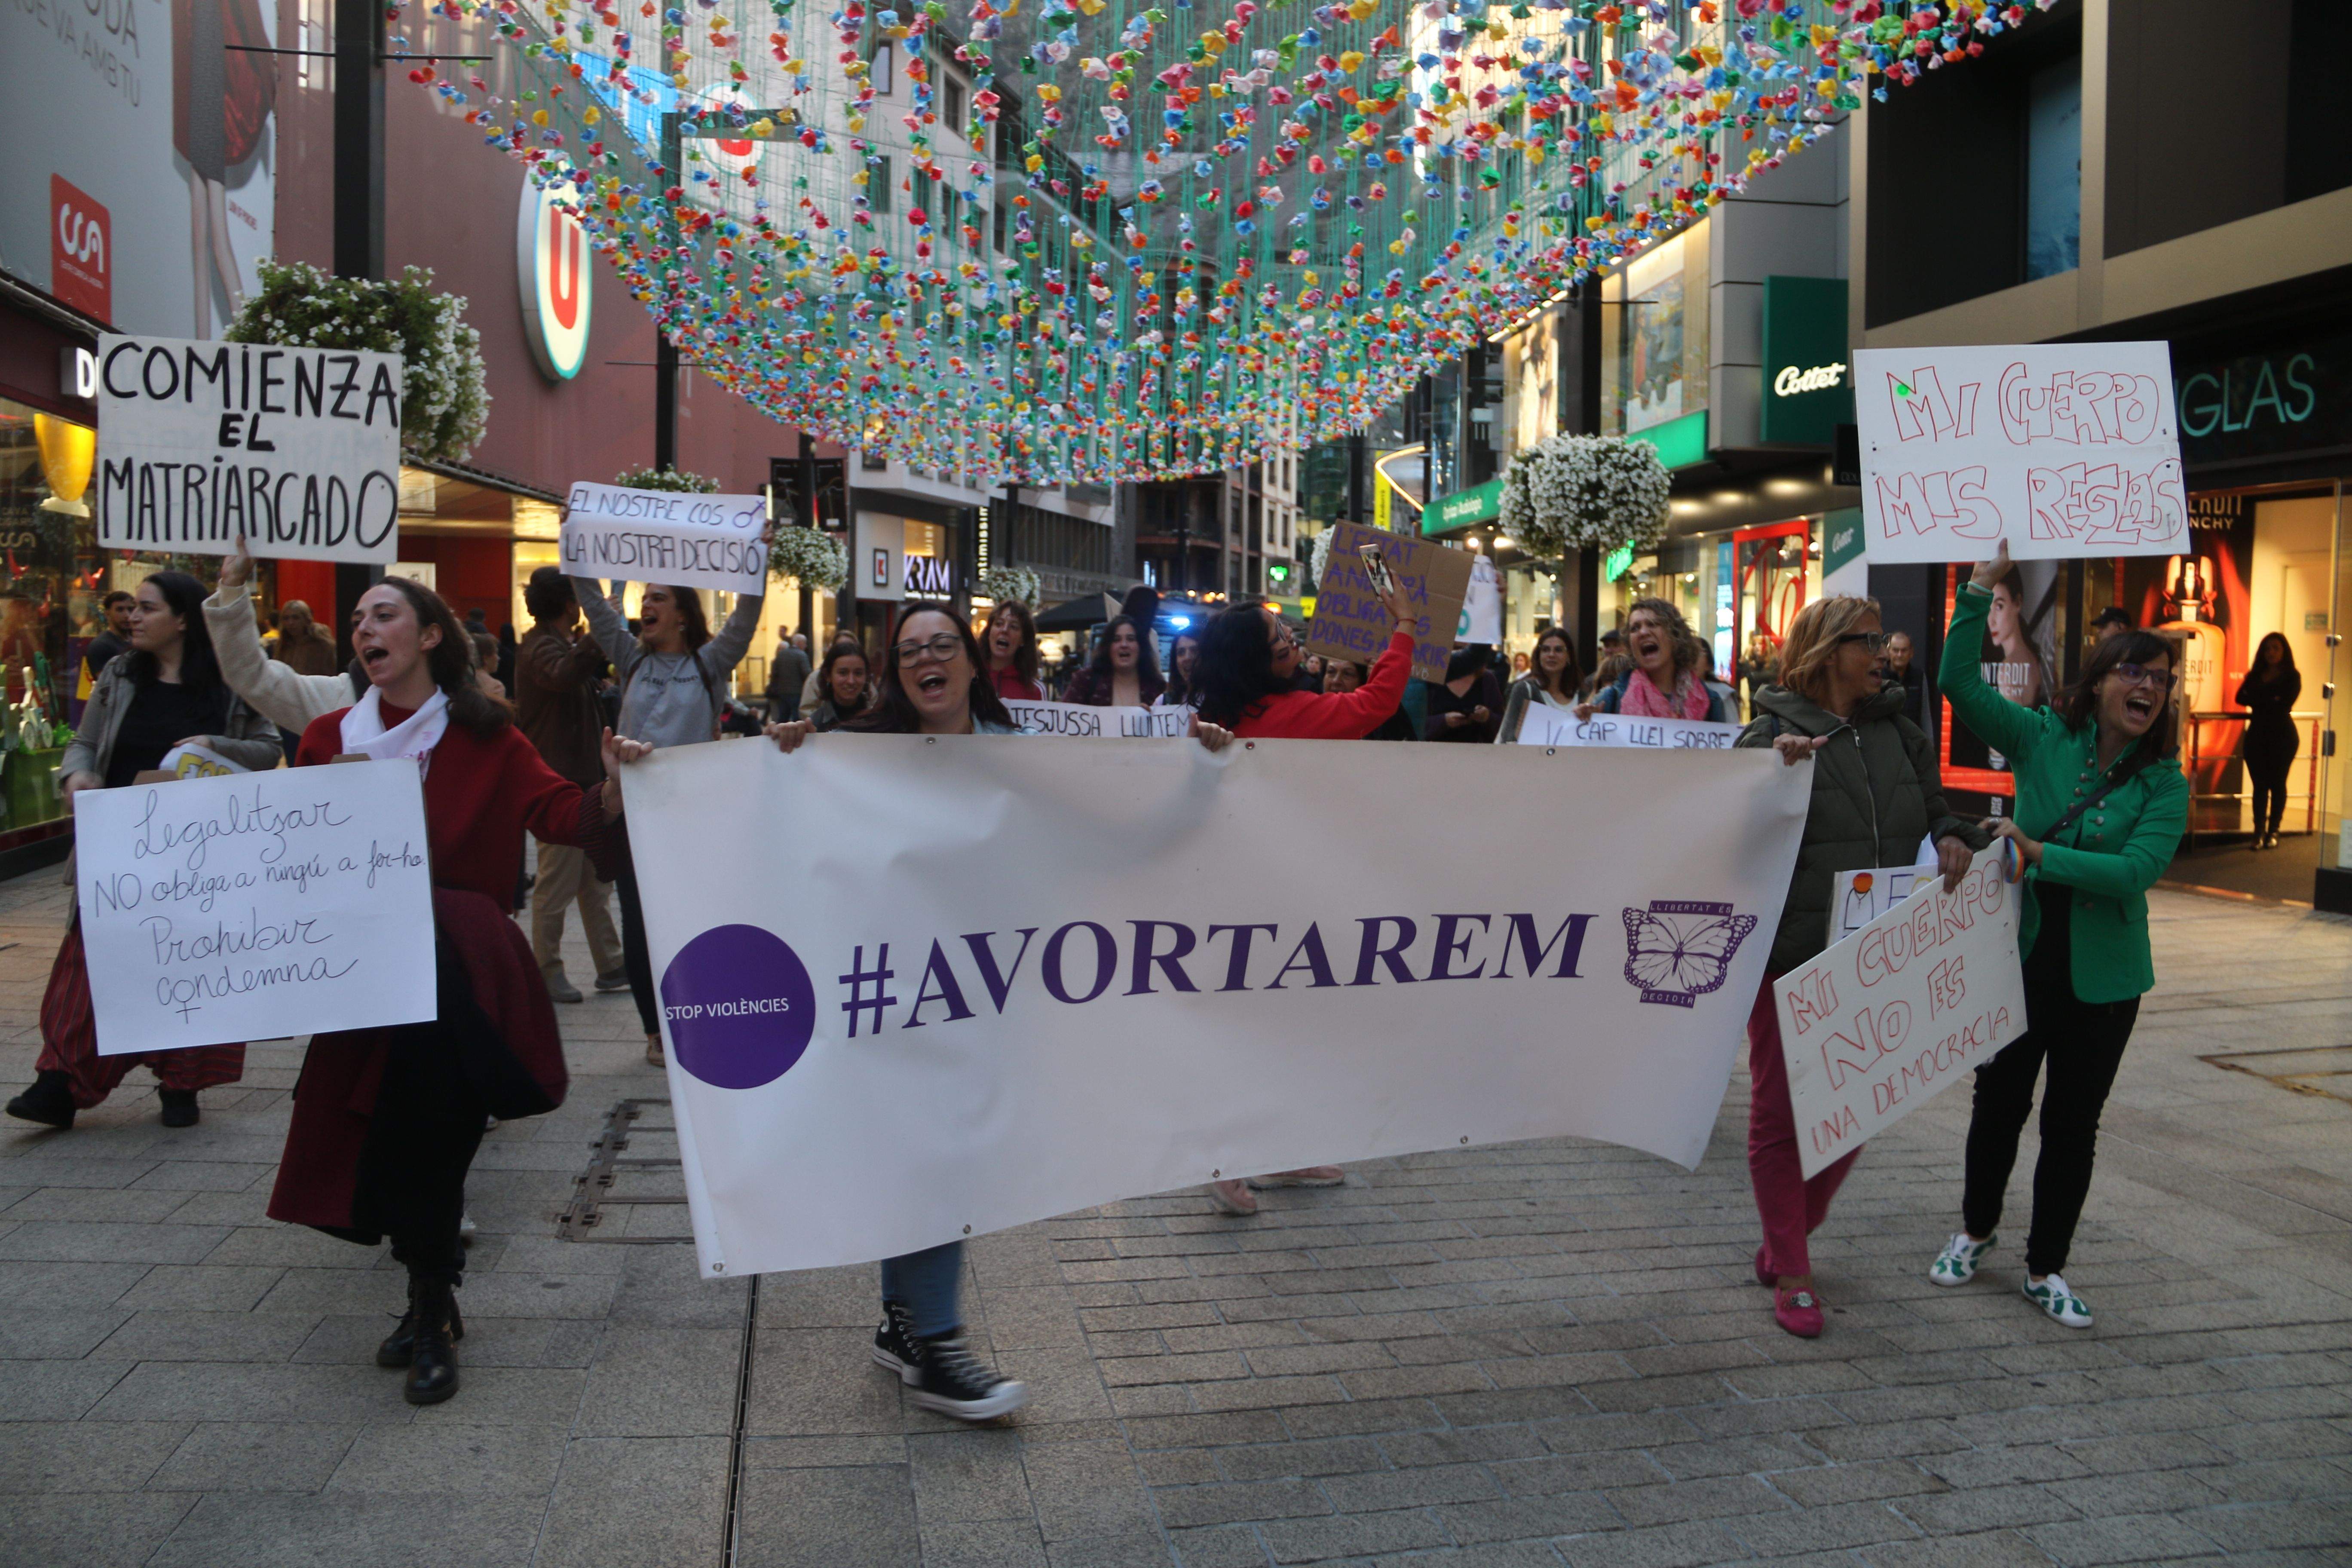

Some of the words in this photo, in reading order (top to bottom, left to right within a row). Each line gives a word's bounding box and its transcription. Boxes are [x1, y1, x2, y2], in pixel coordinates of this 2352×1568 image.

[103, 342, 398, 428] COMIENZA
[1774, 362, 1847, 397] Cottet
[1886, 366, 1981, 442] MI
[1999, 362, 2159, 445] CUERPO
[2175, 353, 2315, 438] GLAS
[218, 413, 276, 451] EL
[103, 456, 398, 548] MATRIARCADO
[570, 490, 591, 513] EL
[597, 493, 682, 521] NOSTRE
[688, 502, 724, 525] COS
[1875, 466, 2003, 539] MIS
[2028, 458, 2183, 545] REGLAS
[565, 534, 587, 562] LA
[593, 533, 676, 569] NOSTRA
[681, 537, 760, 575] DECISIÓ
[1311, 619, 1374, 652] DONES
[1576, 722, 1617, 741] CAP
[1630, 723, 1663, 746] LLEI
[1673, 730, 1730, 749] SOBRE
[135, 784, 352, 870] Legalitzar
[95, 873, 141, 918] NO
[151, 869, 232, 912] obliga
[235, 872, 257, 887] a
[266, 854, 329, 893] ningú
[338, 855, 358, 870] a
[1650, 903, 1712, 911] LLIBERTAT
[139, 907, 334, 965] Prohibir
[1787, 968, 1839, 1035] MI
[1857, 860, 2004, 987] CUERPO
[156, 957, 359, 1024] condemna
[665, 1004, 703, 1020] STOP
[706, 997, 790, 1017] VIOLÈNCIES
[839, 913, 1599, 1038] #AVORTAREM
[1821, 1000, 1912, 1090] NO
[1927, 955, 1966, 1021] ES
[1811, 1105, 1861, 1155] UNA
[1872, 1006, 2009, 1115] DEMOCRACIA
